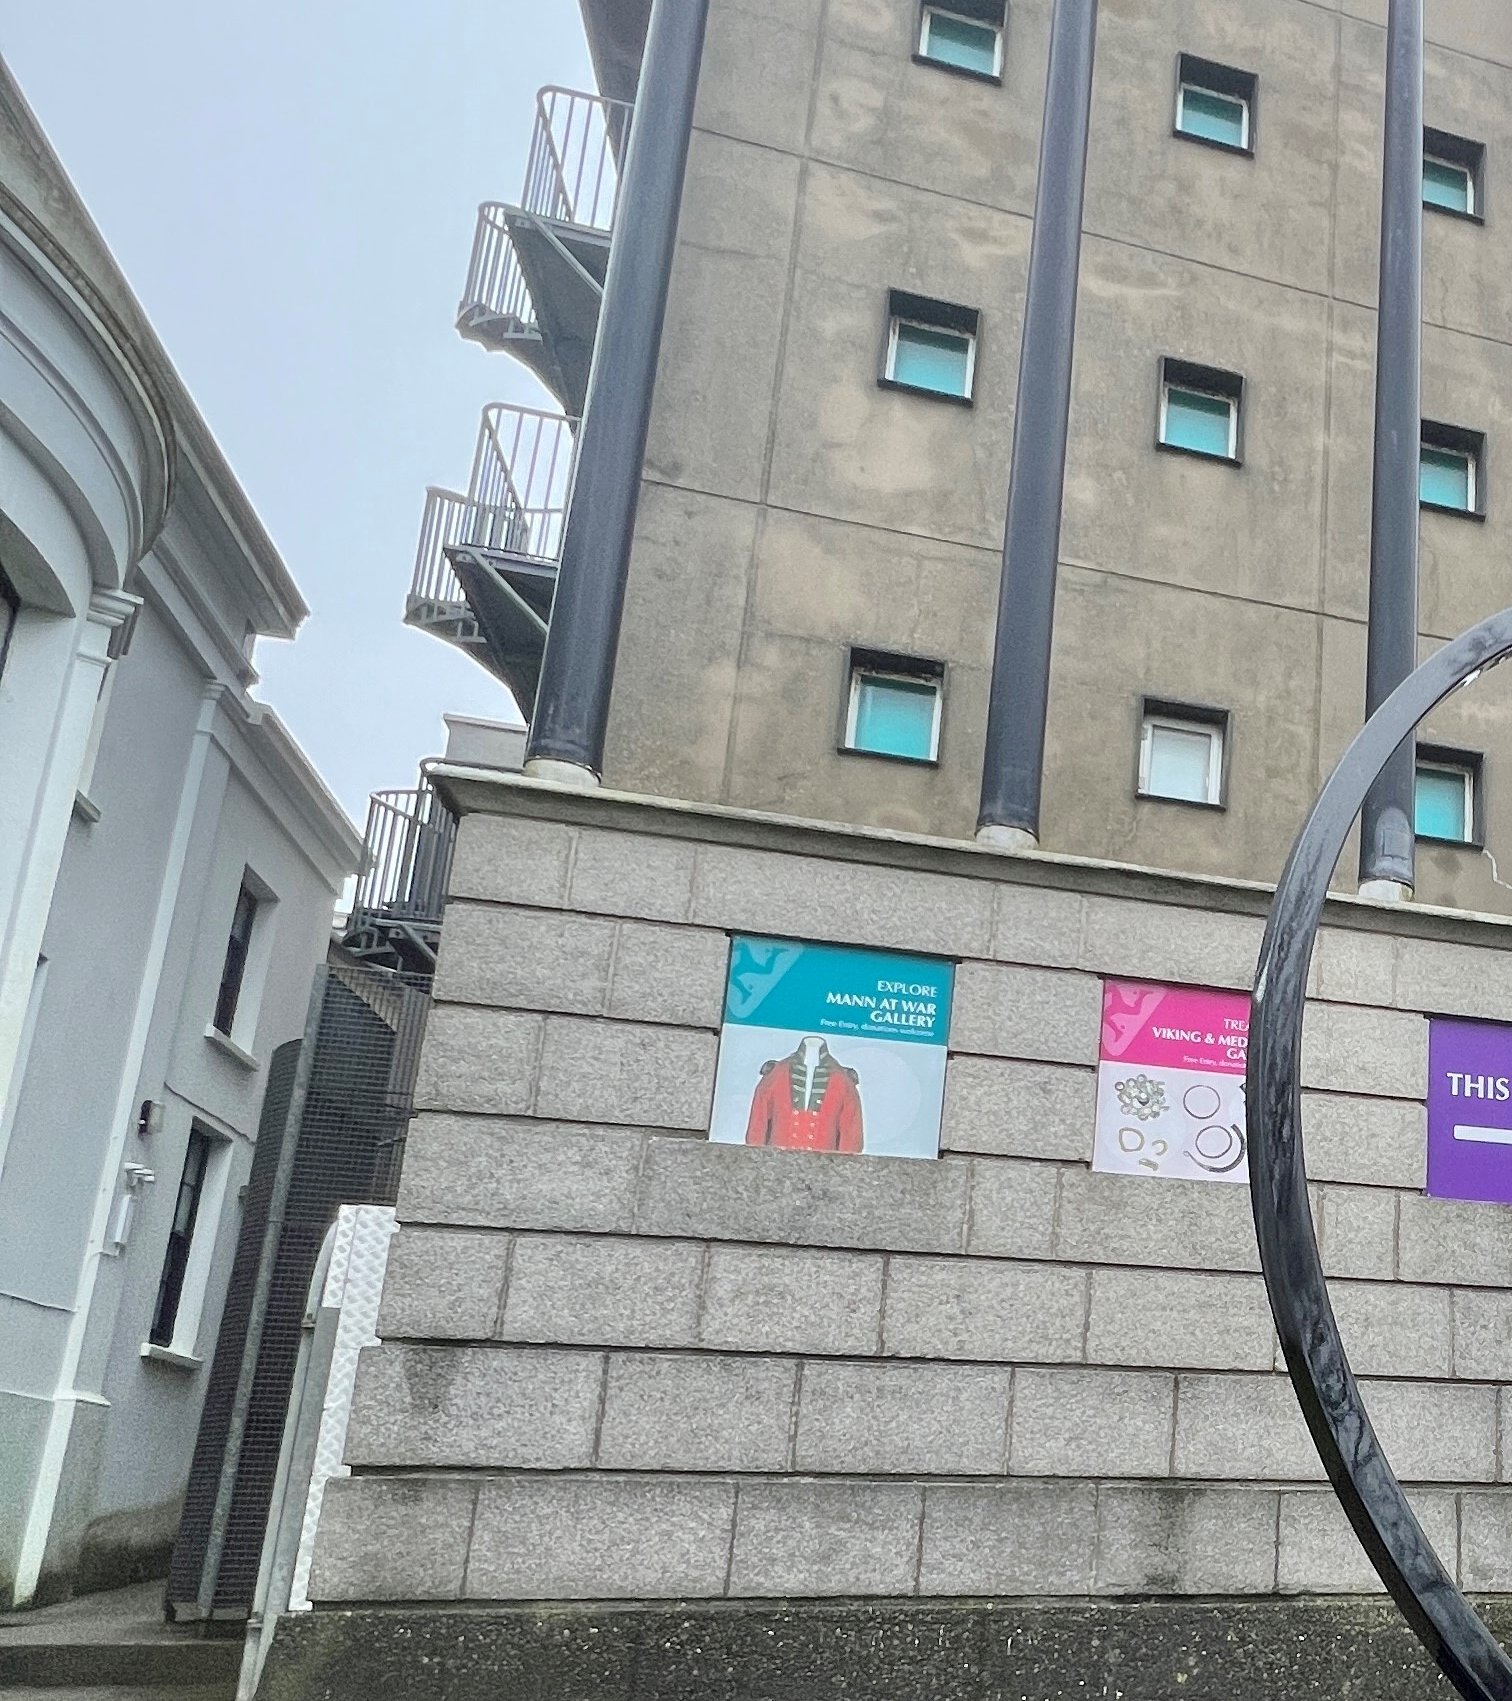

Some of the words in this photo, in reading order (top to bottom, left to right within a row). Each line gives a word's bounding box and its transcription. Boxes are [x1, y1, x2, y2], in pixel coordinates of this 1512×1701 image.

[877, 980, 938, 998] EXPLORE
[826, 992, 877, 1008] MANN
[880, 998, 898, 1010] AT
[901, 1000, 937, 1015] WAR
[870, 1010, 935, 1028] GALLERY
[1152, 1026, 1202, 1043] VIKING
[1204, 1033, 1215, 1044] &
[1218, 1034, 1248, 1048] MED
[1446, 1072, 1510, 1101] THIS
